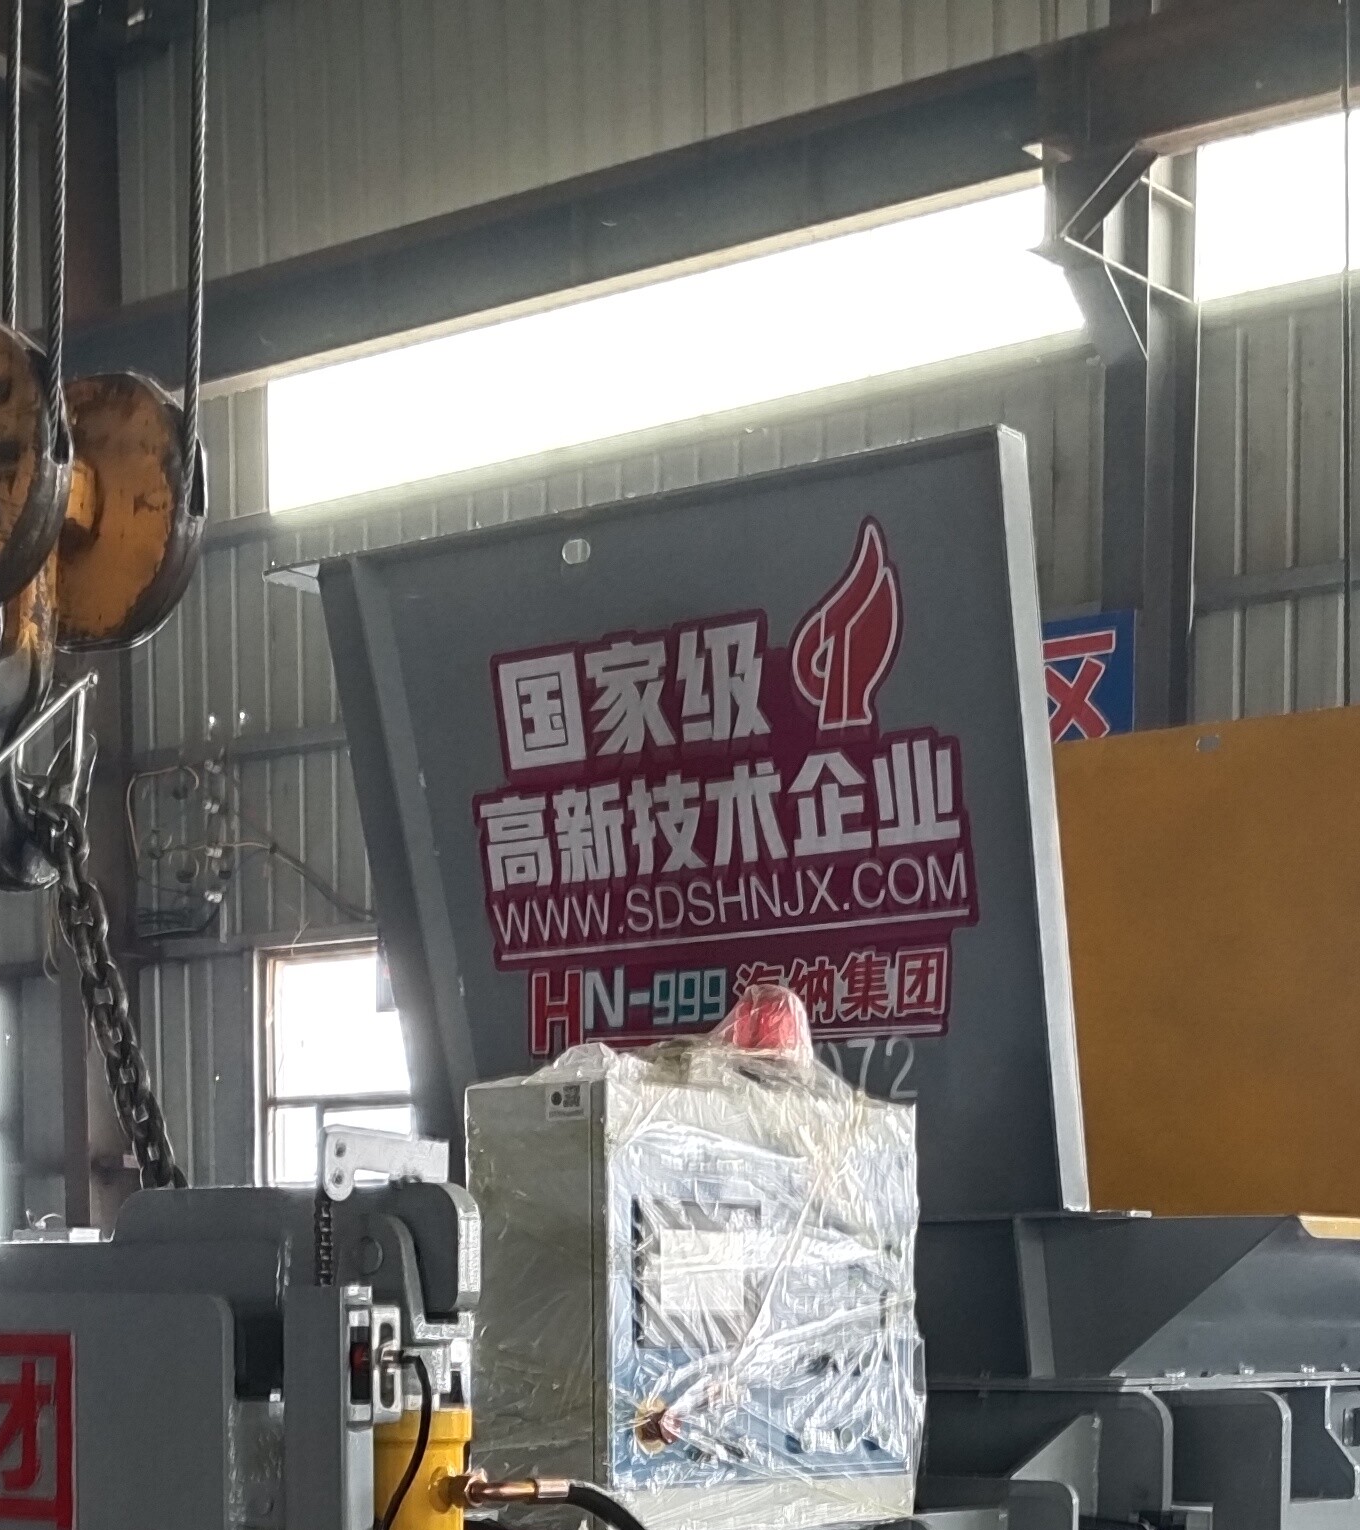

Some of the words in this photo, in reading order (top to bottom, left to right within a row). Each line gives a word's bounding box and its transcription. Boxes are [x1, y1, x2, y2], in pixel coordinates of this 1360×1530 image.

[497, 620, 771, 770] 国家级
[479, 737, 960, 891] 高新技术企业
[494, 852, 968, 946] WWW.SDSHNJX.COM
